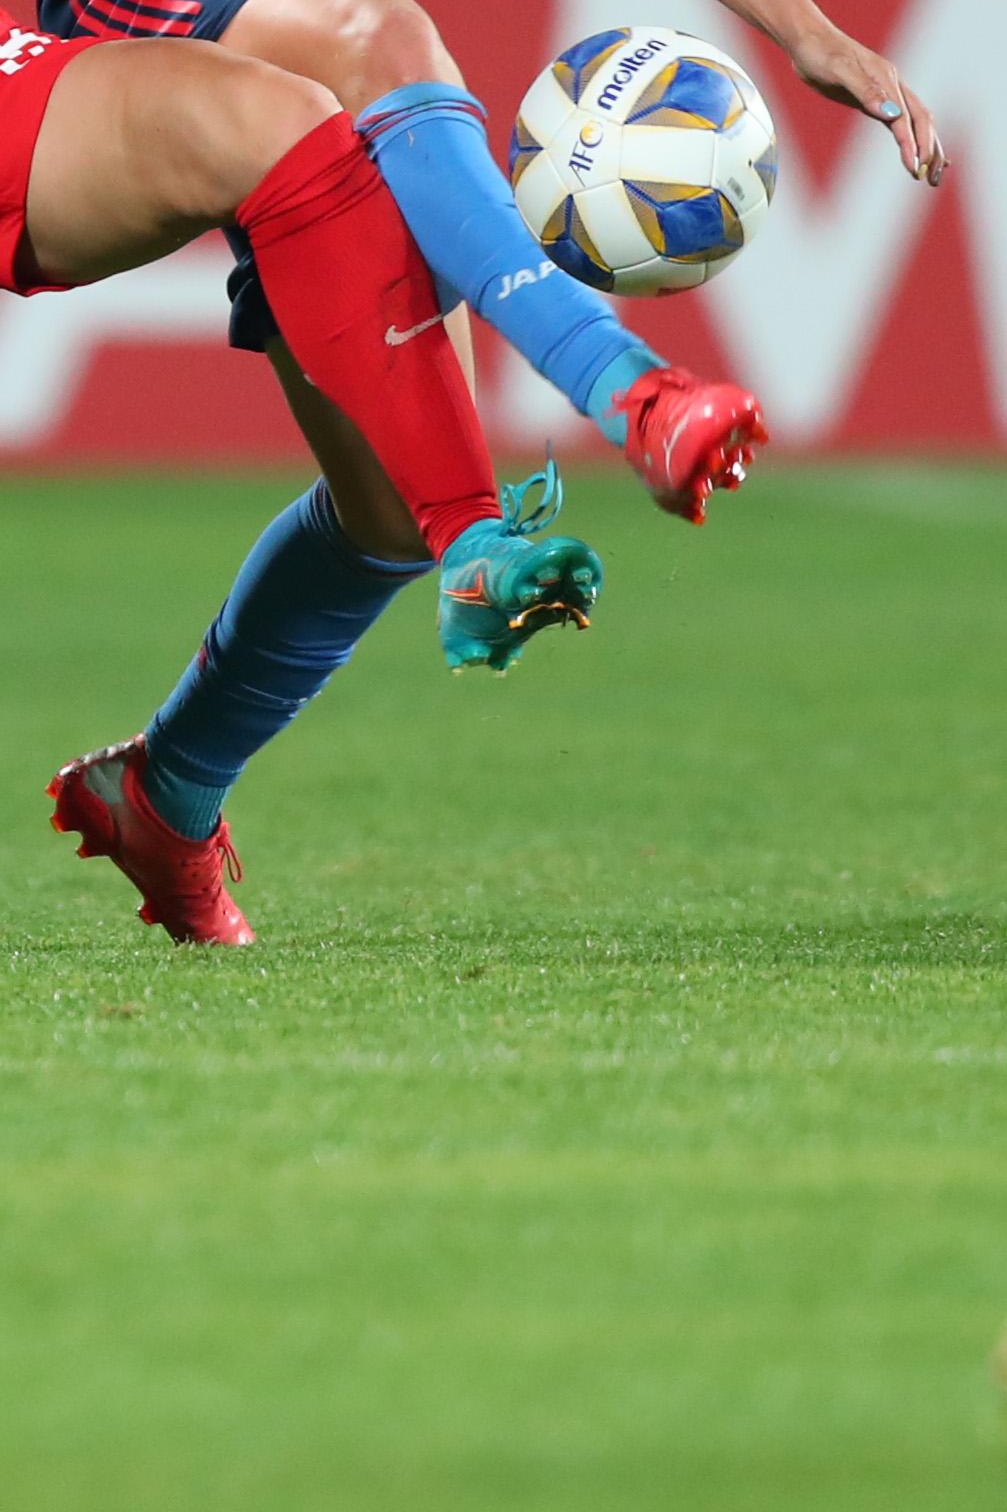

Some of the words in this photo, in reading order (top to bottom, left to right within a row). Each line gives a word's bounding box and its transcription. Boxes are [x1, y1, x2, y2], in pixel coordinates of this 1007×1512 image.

[597, 39, 667, 110] molten
[567, 119, 604, 187] AFC
[497, 260, 564, 300] JAP
